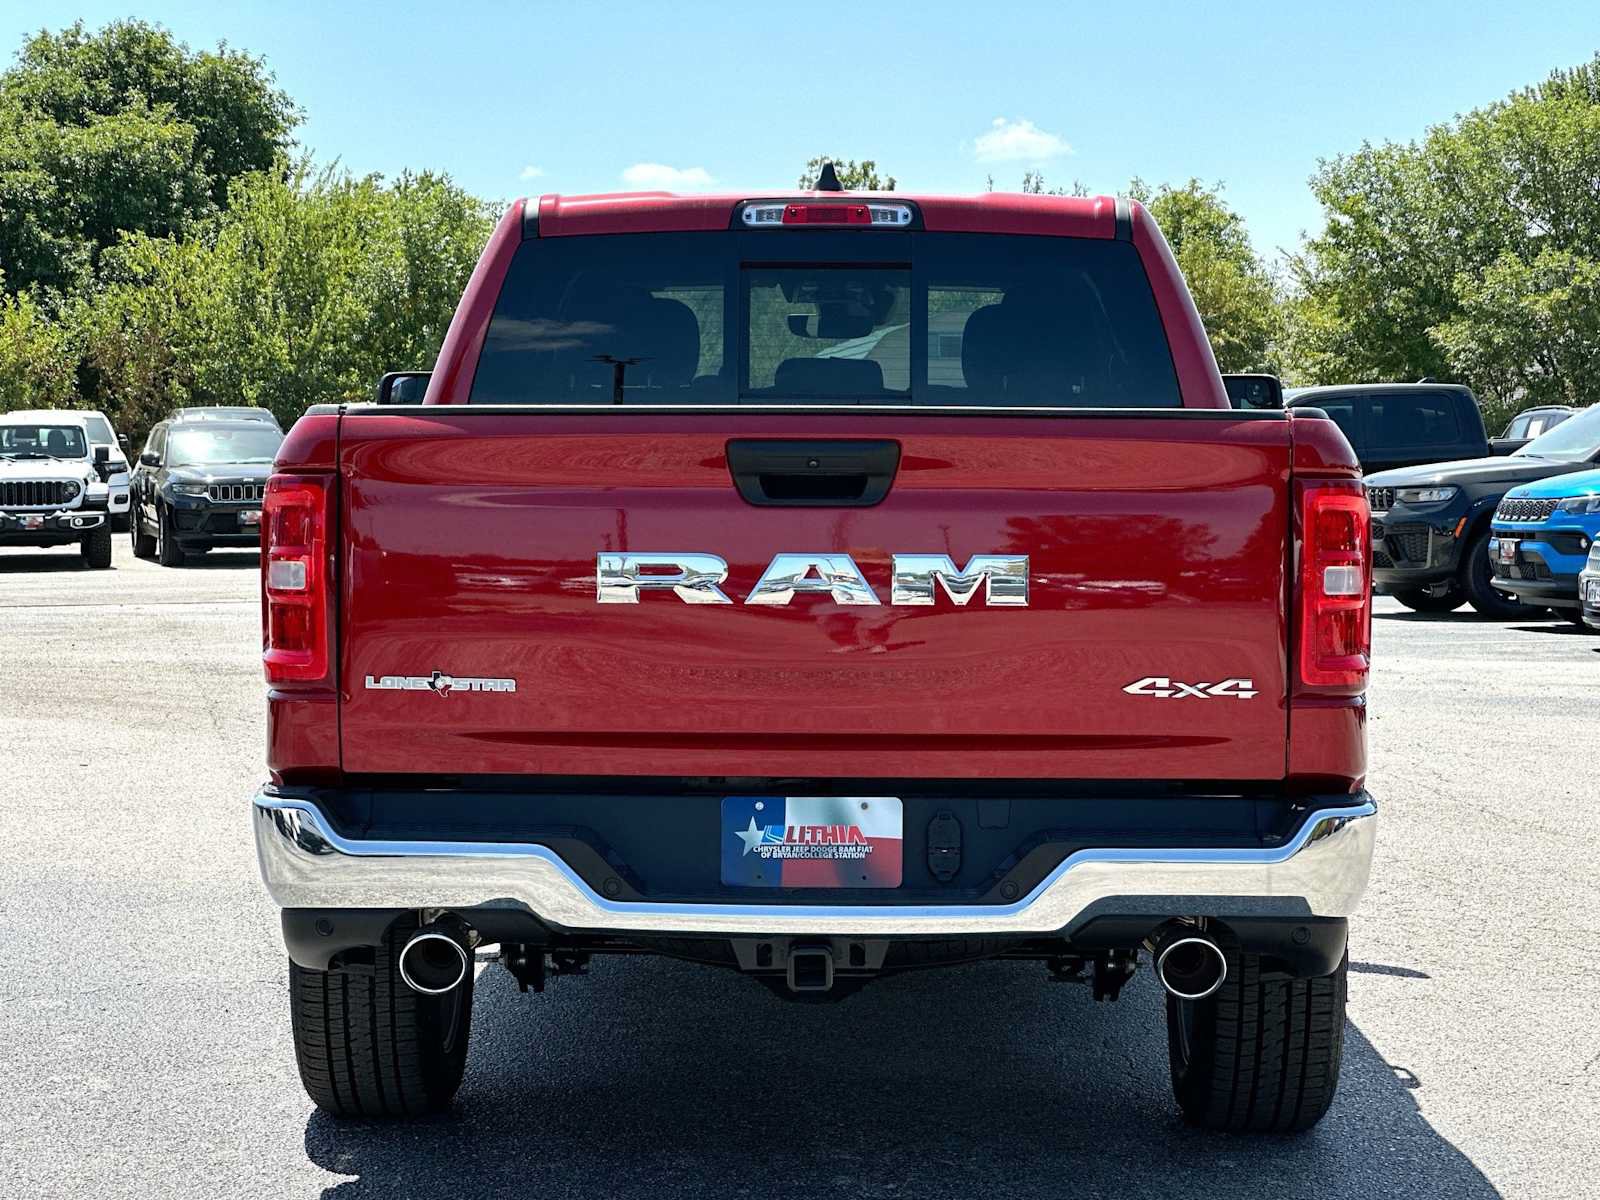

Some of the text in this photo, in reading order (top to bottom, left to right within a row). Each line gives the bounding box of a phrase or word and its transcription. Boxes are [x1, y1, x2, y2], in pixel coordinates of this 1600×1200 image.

[596, 552, 1030, 607] RAM
[365, 675, 516, 692] LONE STAR
[1122, 677, 1260, 699] 4x4
[783, 824, 868, 845] LITHIA
[753, 845, 791, 853] CHRYSLER
